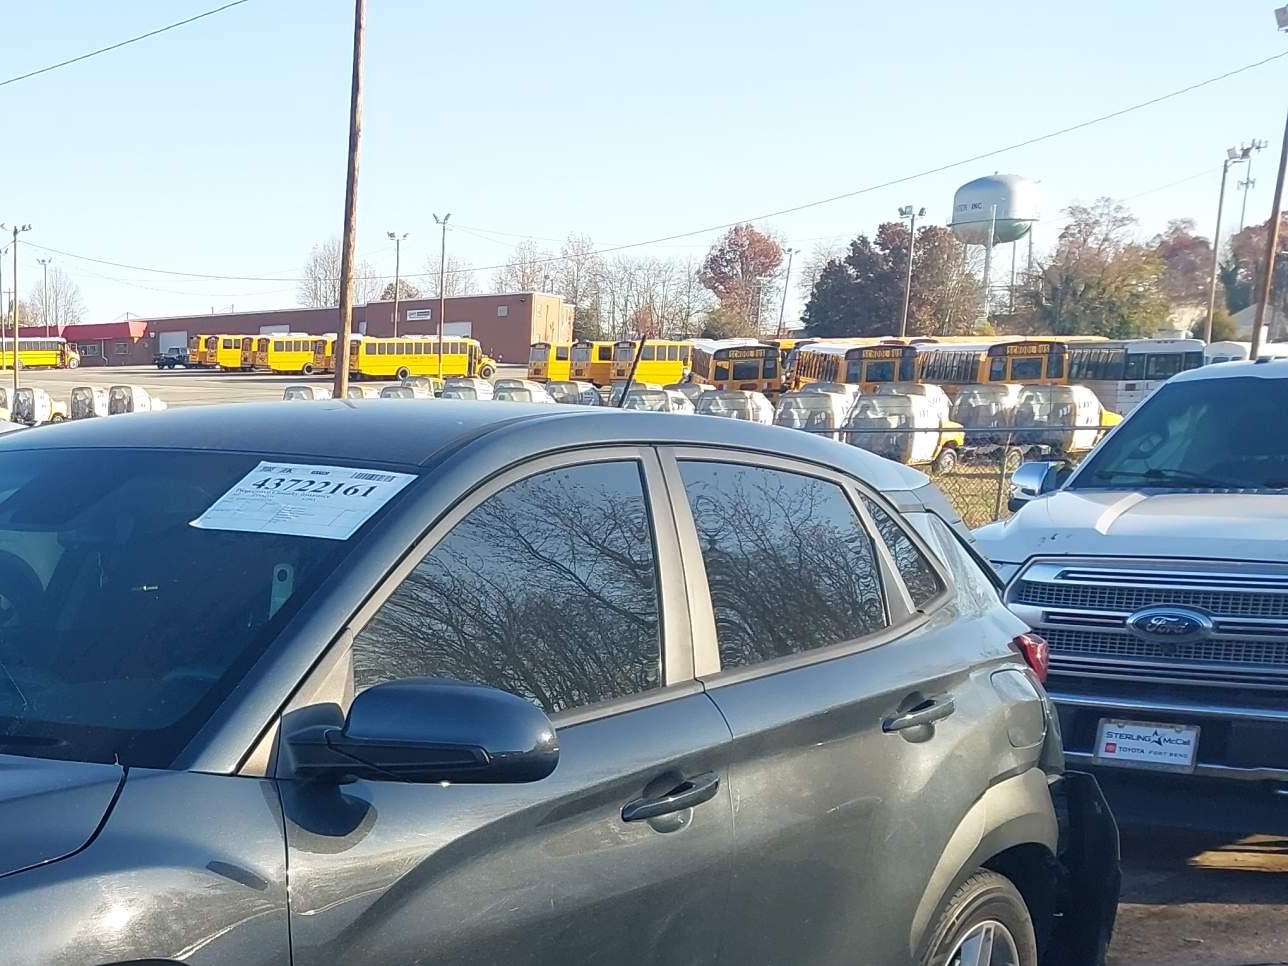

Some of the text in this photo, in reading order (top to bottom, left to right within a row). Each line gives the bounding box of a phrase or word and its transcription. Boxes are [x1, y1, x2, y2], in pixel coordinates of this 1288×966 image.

[253, 477, 377, 497] 43722161
[1146, 616, 1190, 633] Ford
[1105, 731, 1151, 743] STERLING
[1118, 746, 1145, 754] TOYOTA
